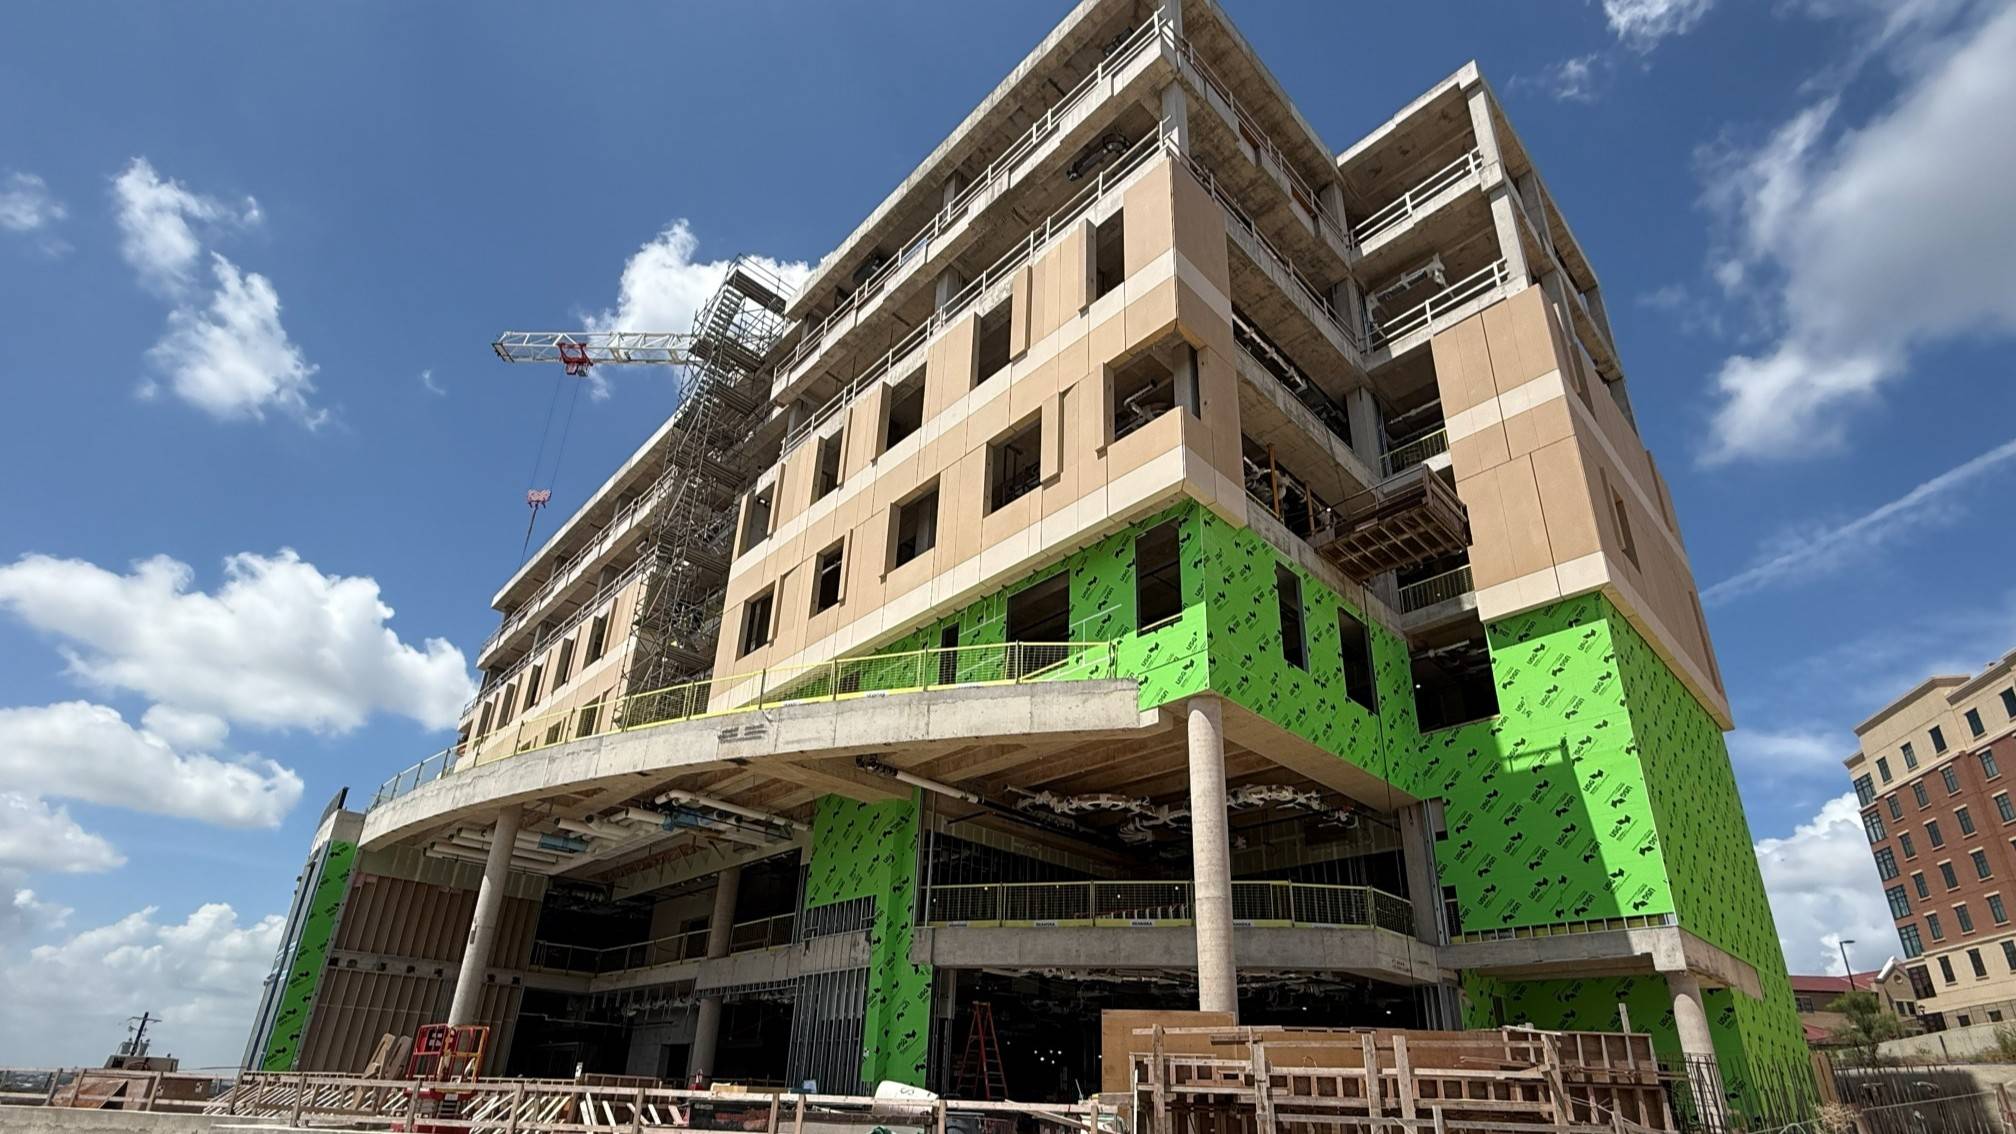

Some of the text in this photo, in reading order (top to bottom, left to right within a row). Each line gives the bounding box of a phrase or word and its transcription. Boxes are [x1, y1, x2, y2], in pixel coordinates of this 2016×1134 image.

[1186, 637, 1197, 650] USG
[1578, 640, 1588, 651] USG
[1141, 654, 1152, 667] USG
[1527, 652, 1538, 665] USG
[1561, 655, 1571, 667] USG
[1175, 671, 1186, 685] USG
[1510, 669, 1520, 680] USG
[1592, 682, 1603, 694] USG
[1539, 694, 1550, 706] USG
[1573, 698, 1584, 709] USG
[1583, 779, 1595, 792] USG
[1620, 785, 1632, 798] USG
[1609, 825, 1622, 838] USG
[1642, 887, 1656, 901] USG
